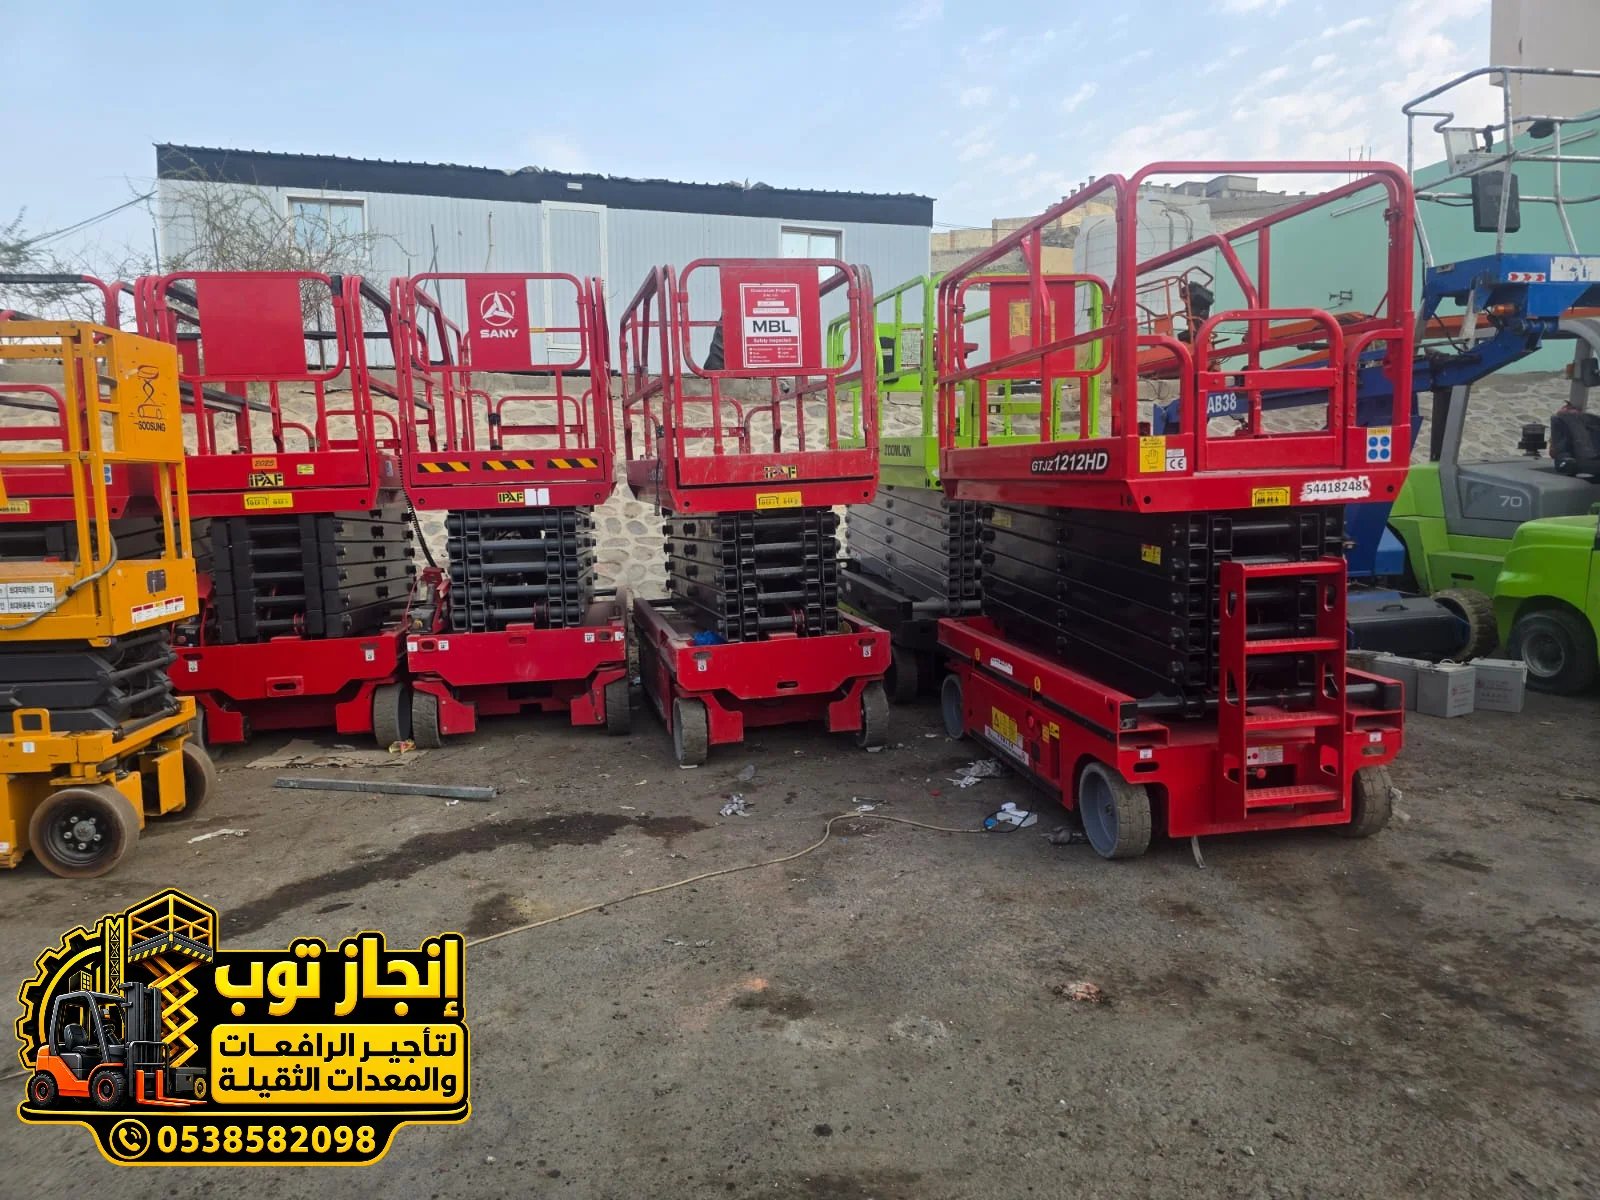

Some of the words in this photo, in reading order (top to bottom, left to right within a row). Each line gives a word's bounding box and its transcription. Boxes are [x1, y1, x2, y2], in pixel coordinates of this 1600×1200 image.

[752, 320, 792, 333] MBL
[480, 329, 518, 339] SANY
[1207, 392, 1237, 414] AB38
[1031, 452, 1108, 472] GTJZ1212HD
[1170, 458, 1184, 470] CE
[1499, 495, 1522, 507] 70
